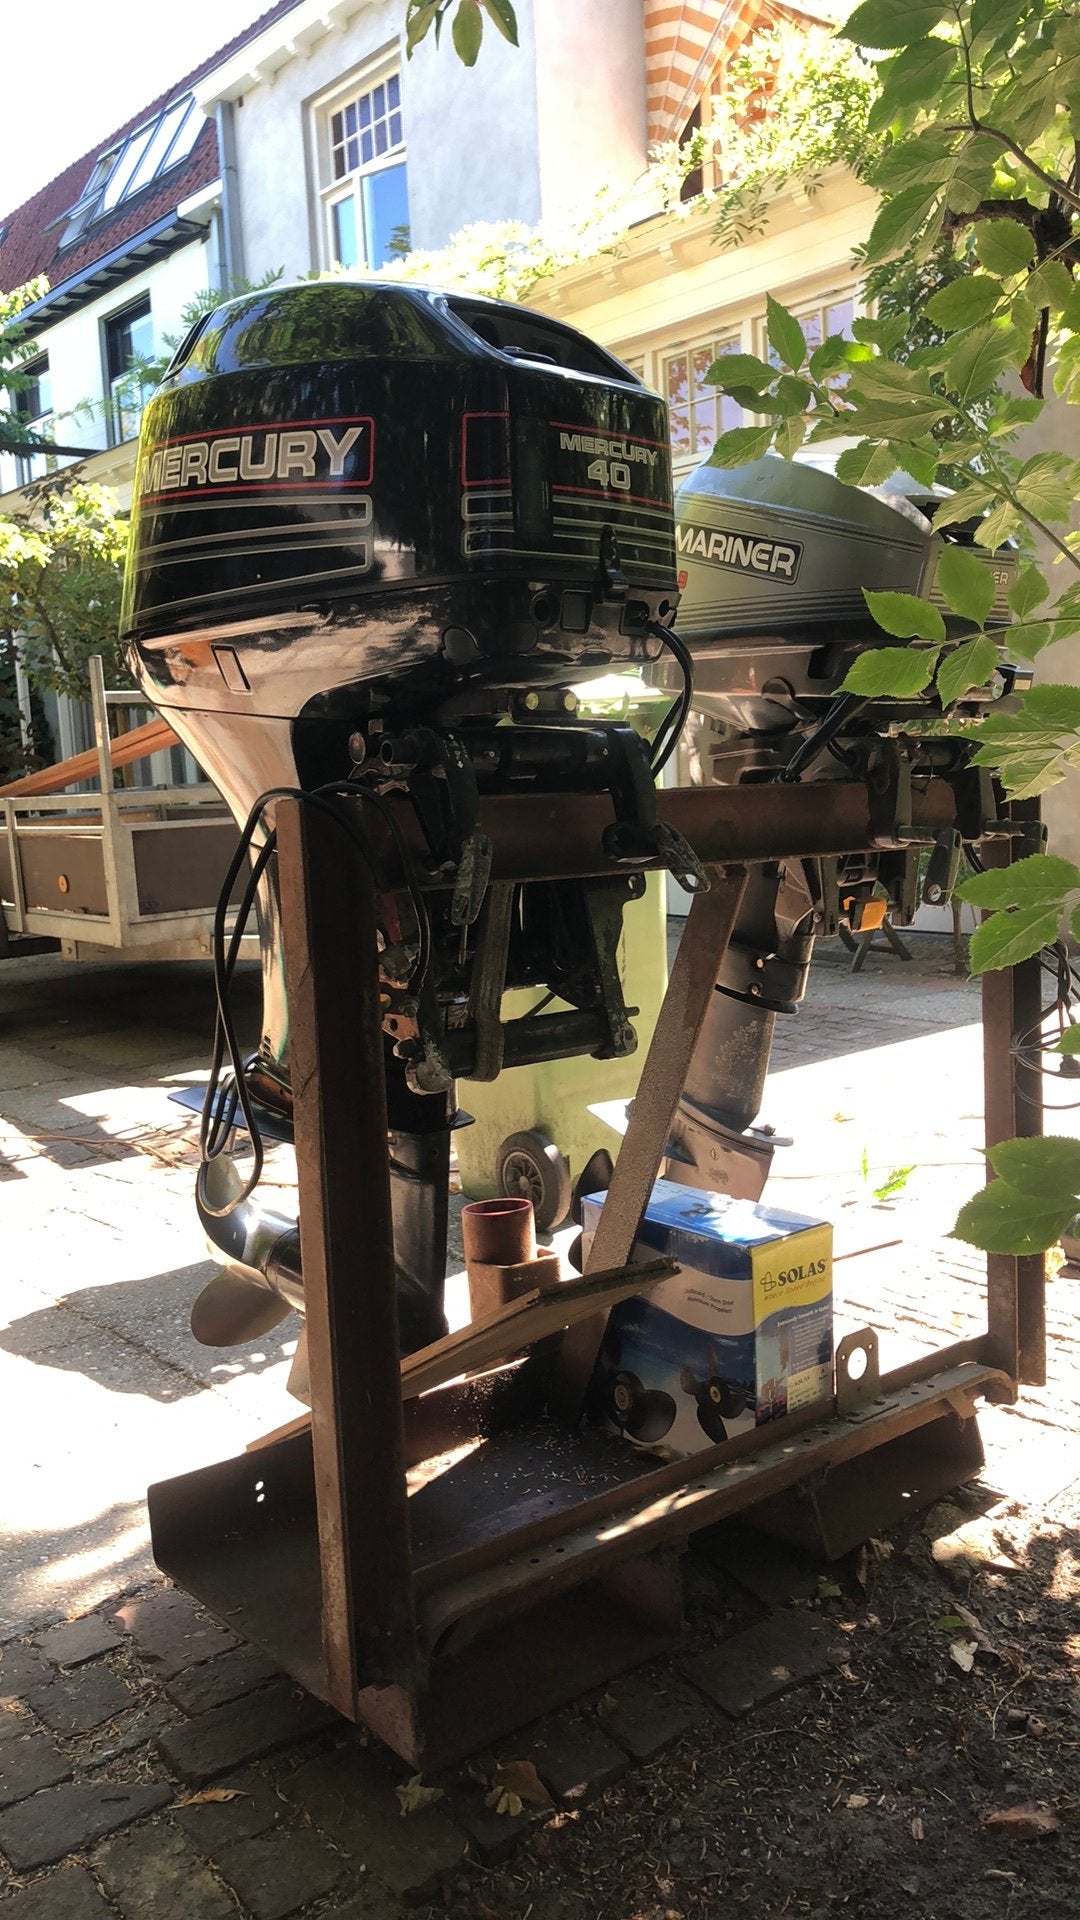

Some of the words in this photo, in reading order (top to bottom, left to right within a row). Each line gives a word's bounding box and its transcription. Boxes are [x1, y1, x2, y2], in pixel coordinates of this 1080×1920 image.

[140, 426, 363, 494] MERCURY
[560, 432, 658, 466] MERCURY
[587, 459, 631, 490] 40
[675, 525, 796, 576] MARINER
[777, 1258, 826, 1287] SOLAS
